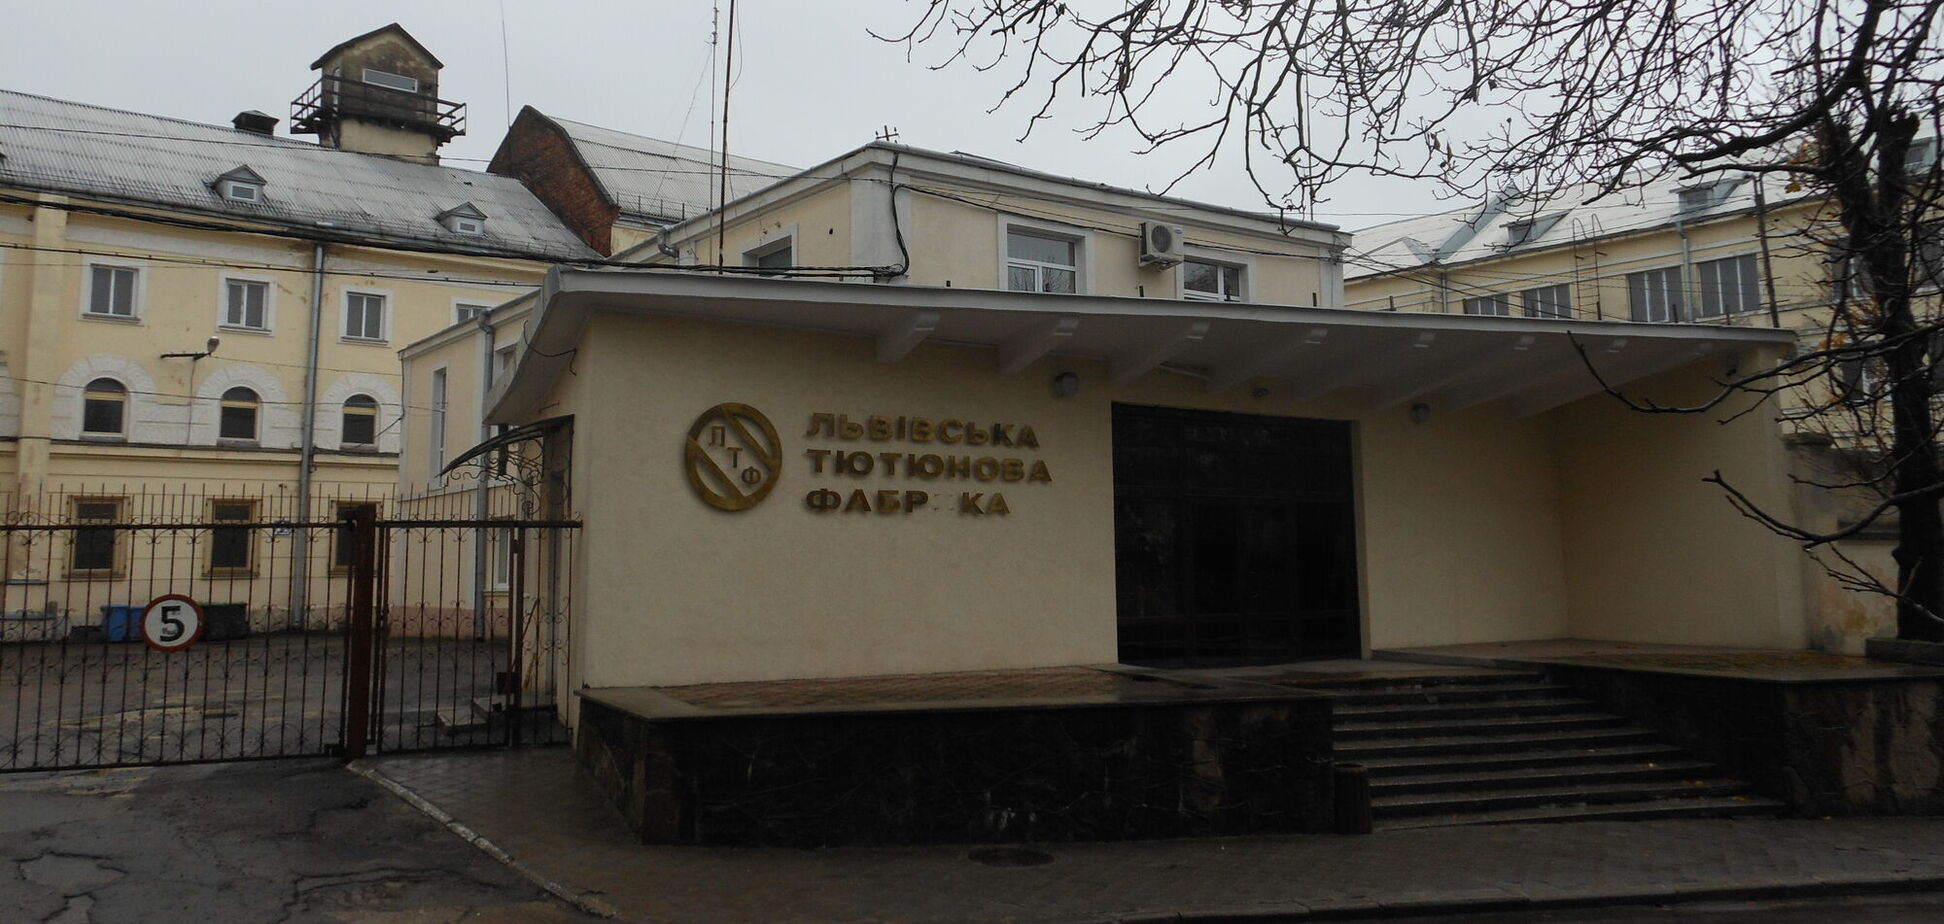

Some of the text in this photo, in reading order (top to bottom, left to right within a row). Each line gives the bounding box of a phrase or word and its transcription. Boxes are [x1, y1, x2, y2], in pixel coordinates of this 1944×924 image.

[806, 412, 1040, 449] ЛЬВІВСЬКА
[806, 448, 1053, 482] ТЮТЮНОВА
[806, 488, 1011, 515] ФАБРКА
[160, 605, 185, 642] 5
